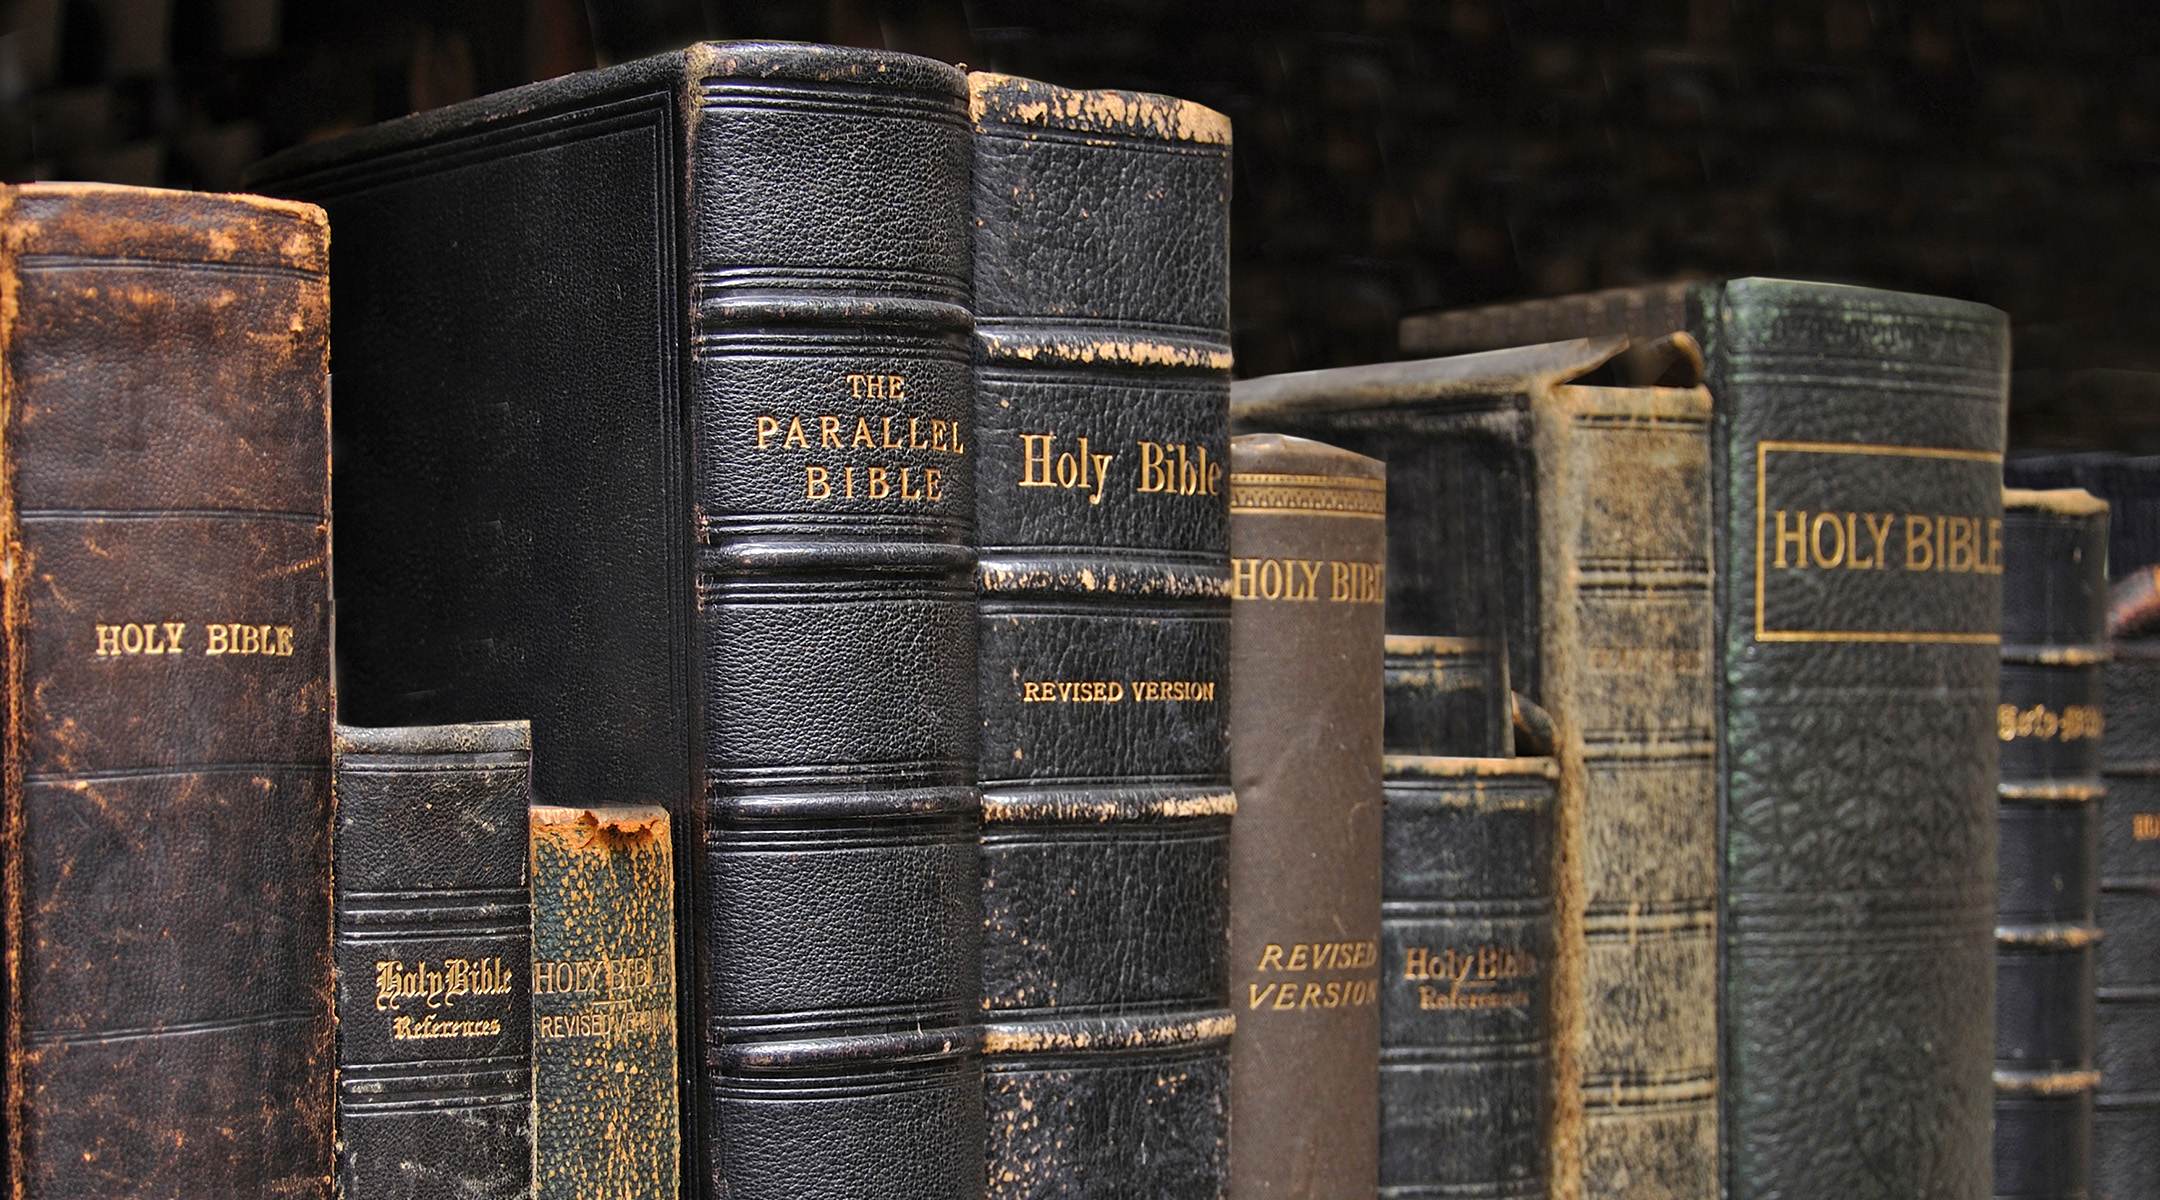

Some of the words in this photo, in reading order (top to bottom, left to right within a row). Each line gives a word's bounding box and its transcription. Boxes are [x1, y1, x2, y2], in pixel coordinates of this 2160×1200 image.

[846, 374, 905, 399] THE
[756, 415, 964, 455] PARALLEL
[806, 465, 943, 500] BIBLE
[1018, 431, 1113, 505] Holy
[1137, 441, 1222, 496] Bible
[1772, 509, 1895, 570] HOLY
[1905, 513, 2004, 575] BIBLE
[1231, 557, 1324, 601] HOLY
[1329, 560, 1386, 604] BIBL
[95, 622, 186, 656] HOLY
[206, 623, 294, 657] BIBLE
[1023, 681, 1124, 703] REVISED
[1131, 680, 1216, 703] VERSION
[534, 960, 604, 994] HOLY
[610, 954, 670, 991] BIBLE
[1257, 941, 1378, 972] REVISED
[1404, 946, 1475, 984] Holy
[376, 959, 443, 1011] Holy
[444, 957, 513, 1007] Bible
[393, 1013, 501, 1040] References
[541, 1013, 611, 1038] REVISED
[615, 1007, 668, 1034] VERSI
